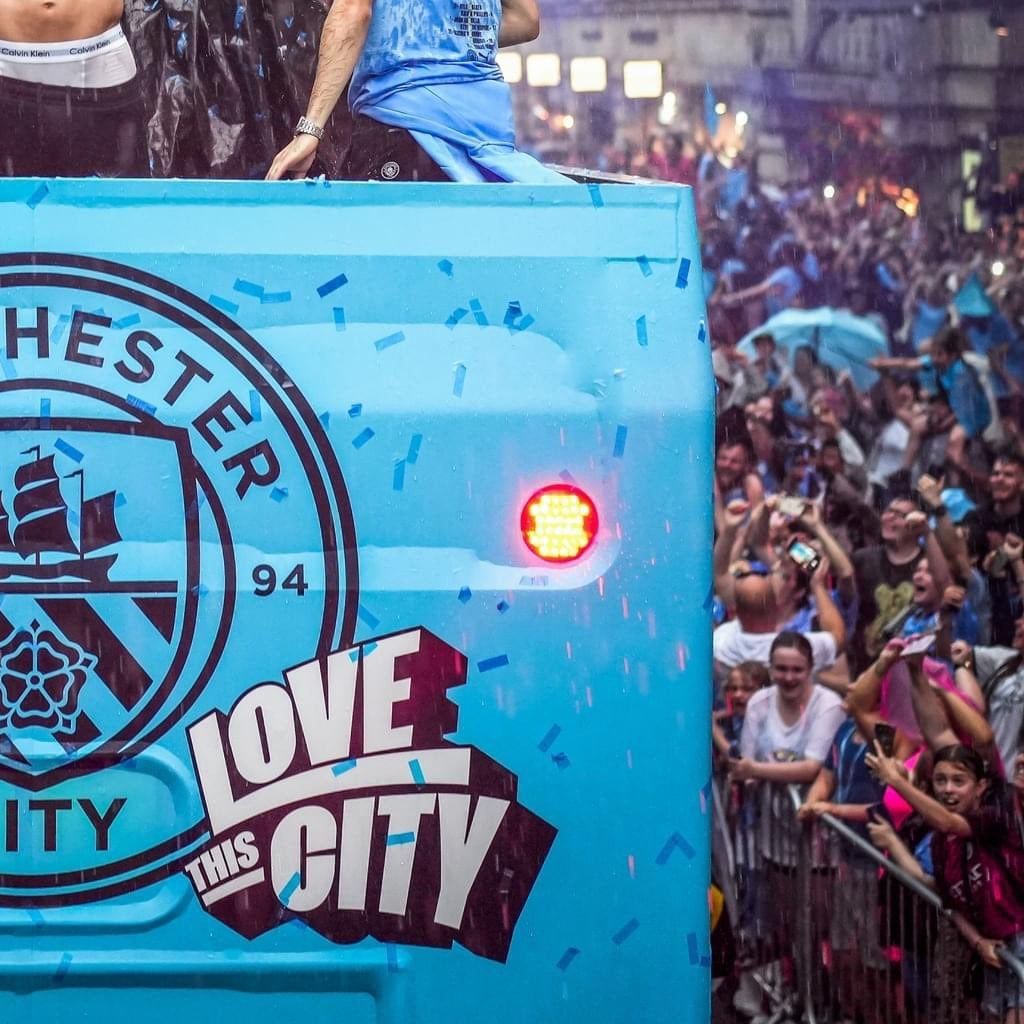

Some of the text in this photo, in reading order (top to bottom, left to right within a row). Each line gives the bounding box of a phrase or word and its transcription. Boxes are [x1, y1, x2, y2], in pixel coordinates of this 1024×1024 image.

[1, 47, 50, 57] Calvin Klein
[69, 39, 110, 55] Calvin Klein
[251, 564, 309, 597] 94
[189, 629, 422, 835] LOVE
[184, 792, 511, 930] THIS CITY
